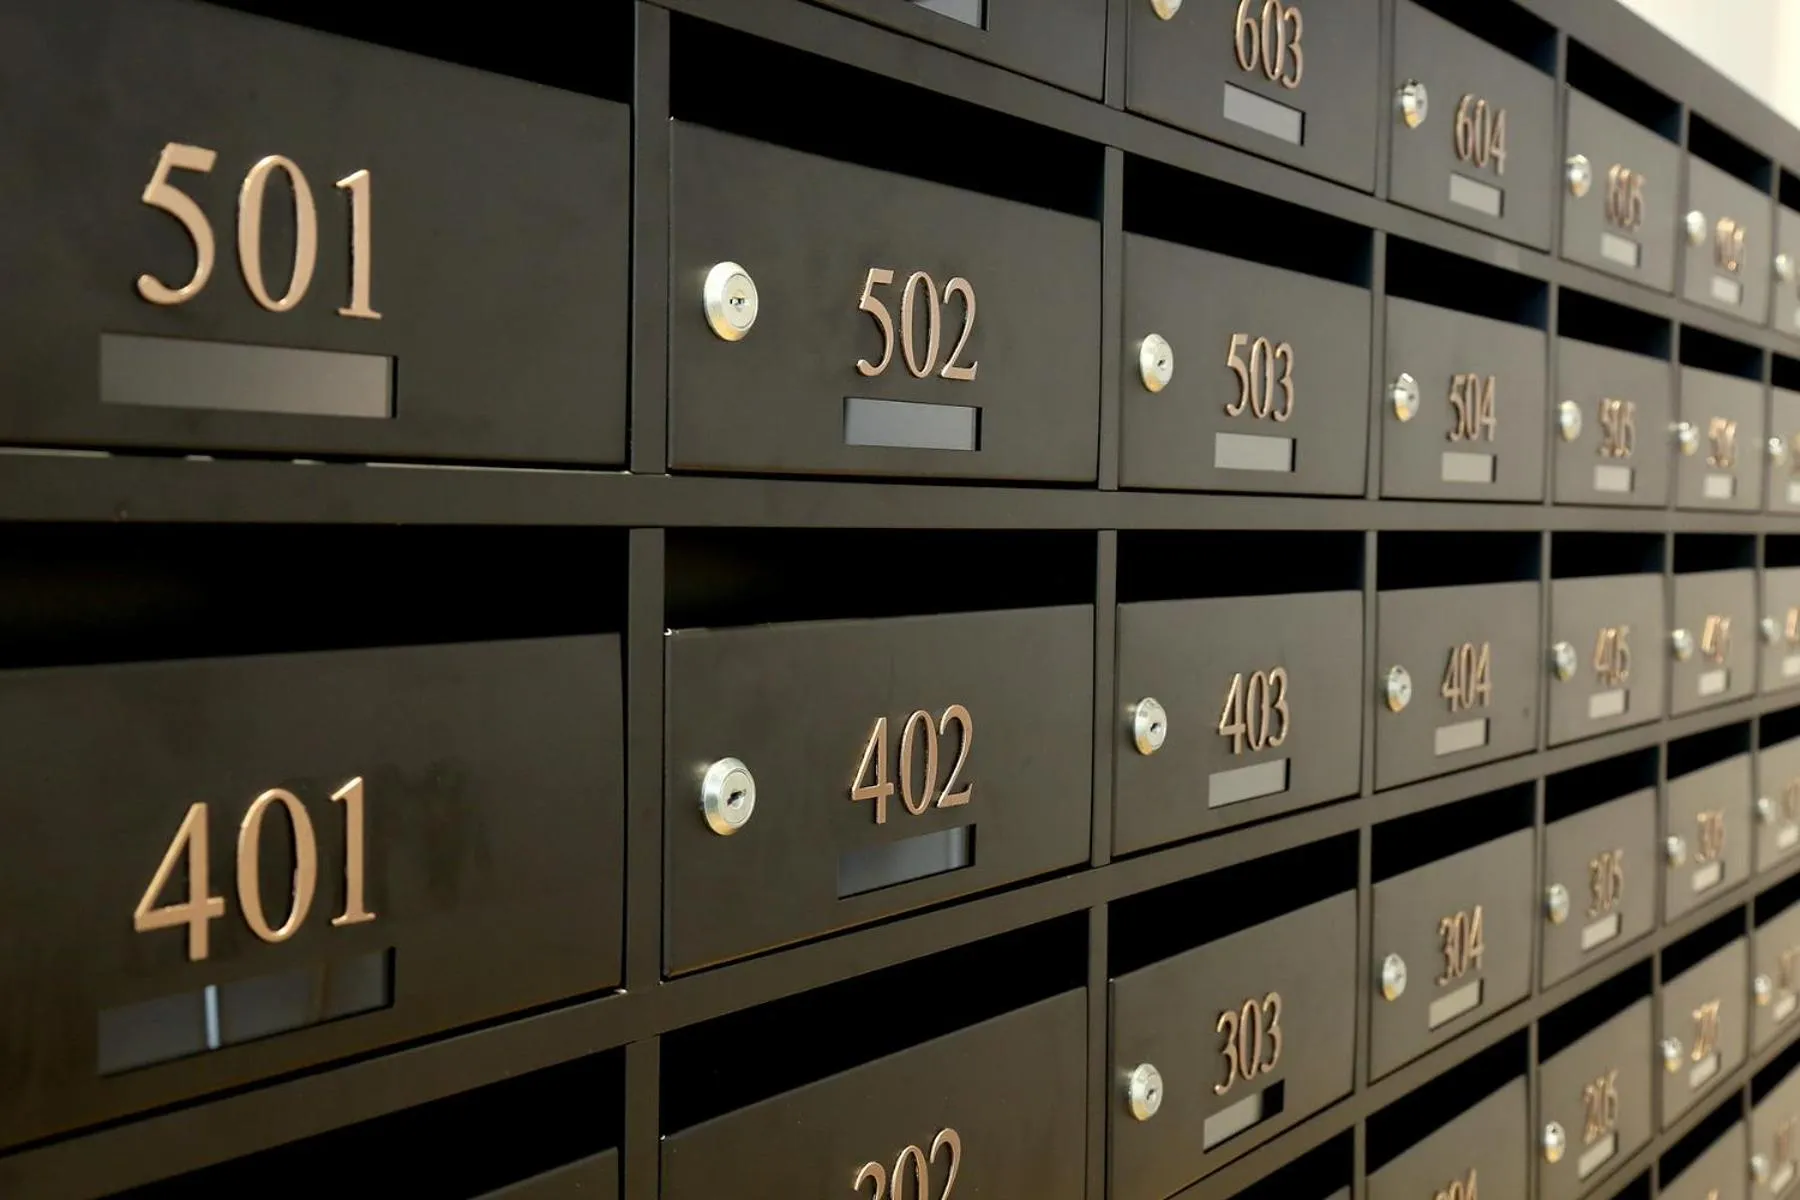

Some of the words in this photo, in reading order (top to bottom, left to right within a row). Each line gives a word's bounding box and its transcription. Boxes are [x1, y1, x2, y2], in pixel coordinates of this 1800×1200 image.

[1235, 0, 1304, 90] 603
[1455, 93, 1508, 176] 604
[137, 142, 382, 319] 501
[856, 267, 978, 381] 502
[1226, 333, 1295, 423] 503
[1448, 372, 1498, 442] 504
[1217, 666, 1290, 755] 403
[1440, 641, 1493, 713] 404
[851, 704, 973, 825] 402
[134, 776, 376, 961] 401
[1435, 904, 1486, 987] 304
[1213, 991, 1283, 1097] 303
